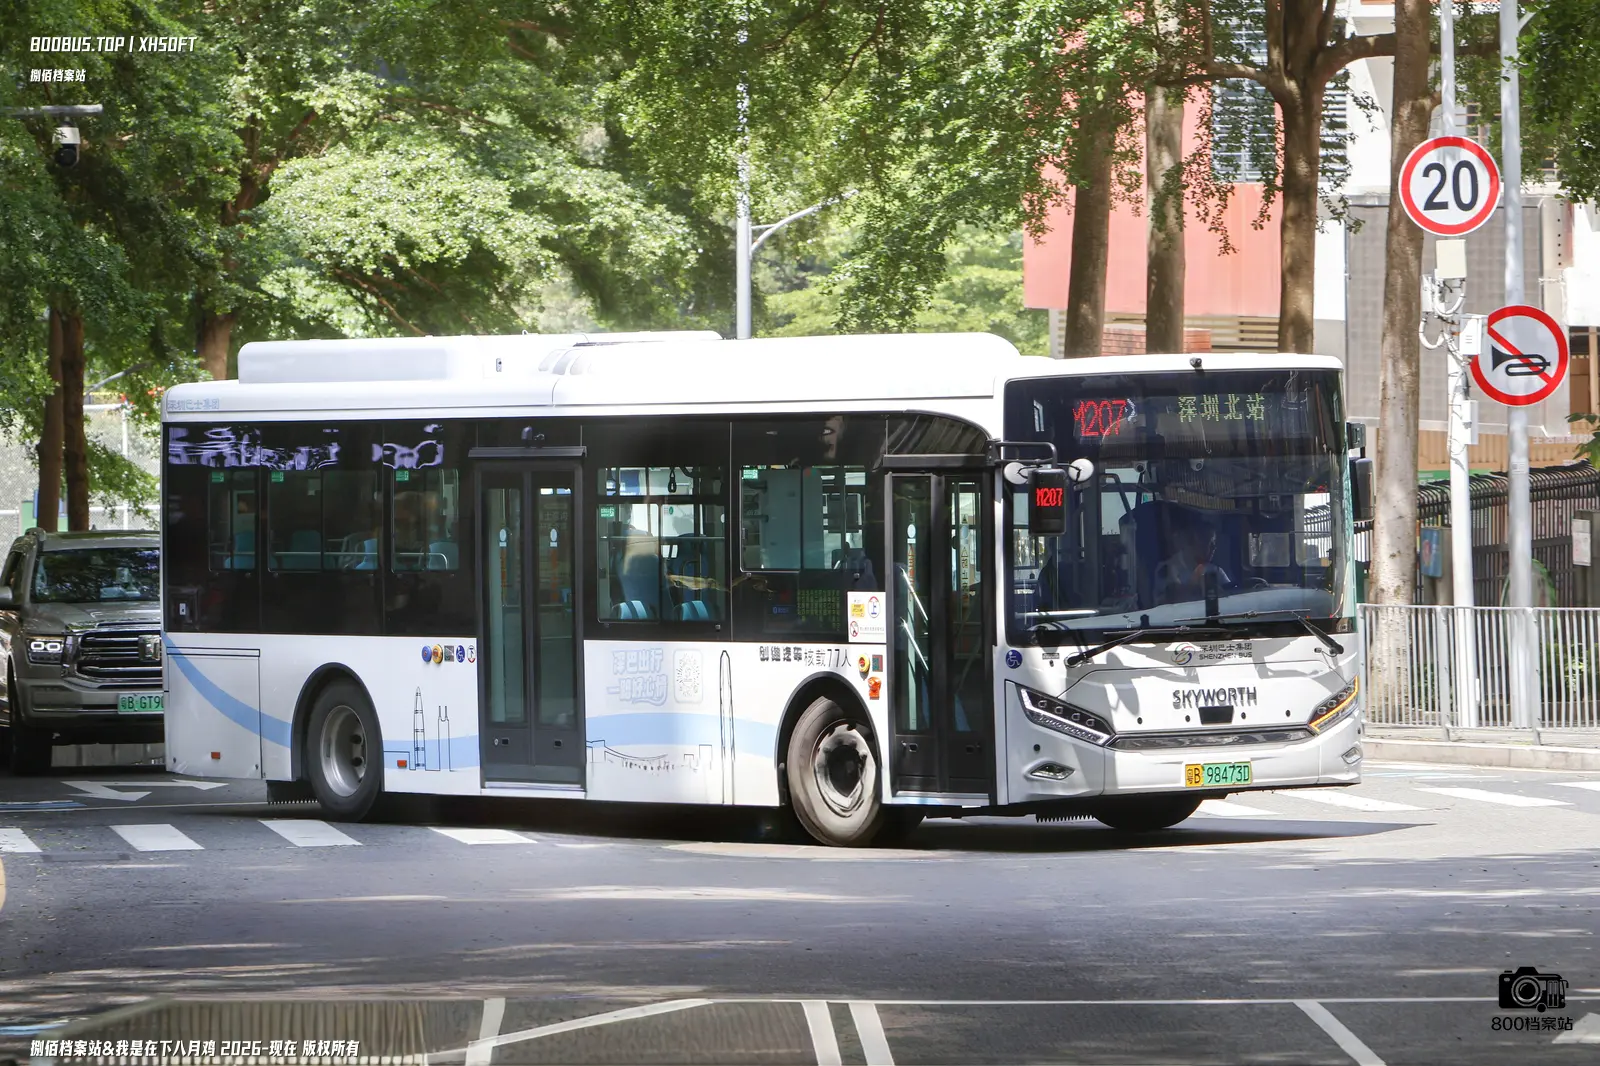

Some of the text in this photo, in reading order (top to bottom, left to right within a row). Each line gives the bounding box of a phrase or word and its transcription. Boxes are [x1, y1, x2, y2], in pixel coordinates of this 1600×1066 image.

[1422, 159, 1479, 212] 20
[1178, 393, 1266, 423] 深圳北站
[1036, 488, 1063, 507] M207
[1199, 653, 1237, 661] SHENZHEN
[1200, 643, 1253, 652] 深圳巴士集团
[1172, 686, 1258, 706] SKYWORTH
